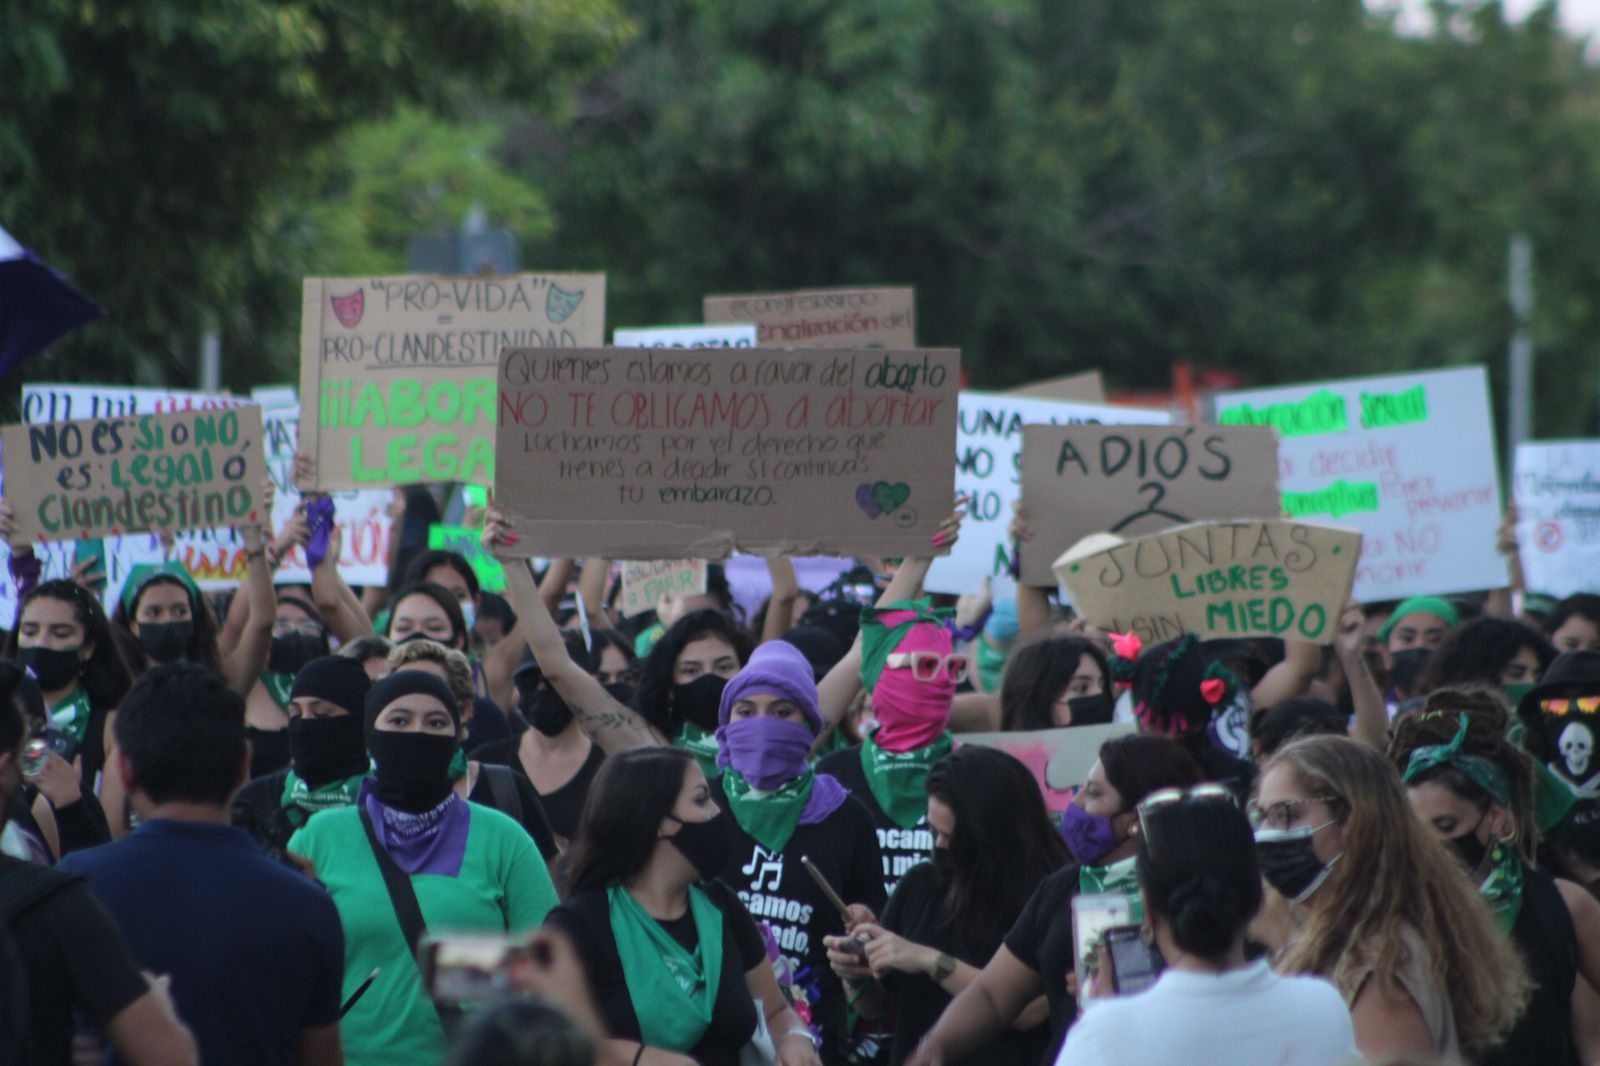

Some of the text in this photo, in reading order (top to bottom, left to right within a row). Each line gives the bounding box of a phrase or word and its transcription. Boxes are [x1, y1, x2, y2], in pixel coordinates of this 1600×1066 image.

[504, 351, 611, 385] Quienes
[626, 354, 711, 385] estamos
[730, 361, 747, 384] a
[820, 357, 856, 387] del
[864, 355, 947, 393] aborto
[500, 391, 548, 428] NO
[568, 391, 598, 429] TE
[610, 390, 770, 430] OBLIGAMOS
[825, 387, 945, 429] abortar
[29, 422, 83, 464] NO
[661, 434, 697, 458] por
[710, 428, 732, 456] el
[742, 432, 838, 459] derecho
[846, 430, 885, 461] que
[1056, 428, 1232, 480] ADIÓS
[635, 460, 653, 478] a
[663, 455, 733, 480] decidir
[1099, 522, 1317, 588] JUNTAS
[1170, 564, 1290, 599] LIBRES
[1206, 598, 1327, 638] MIEDO
